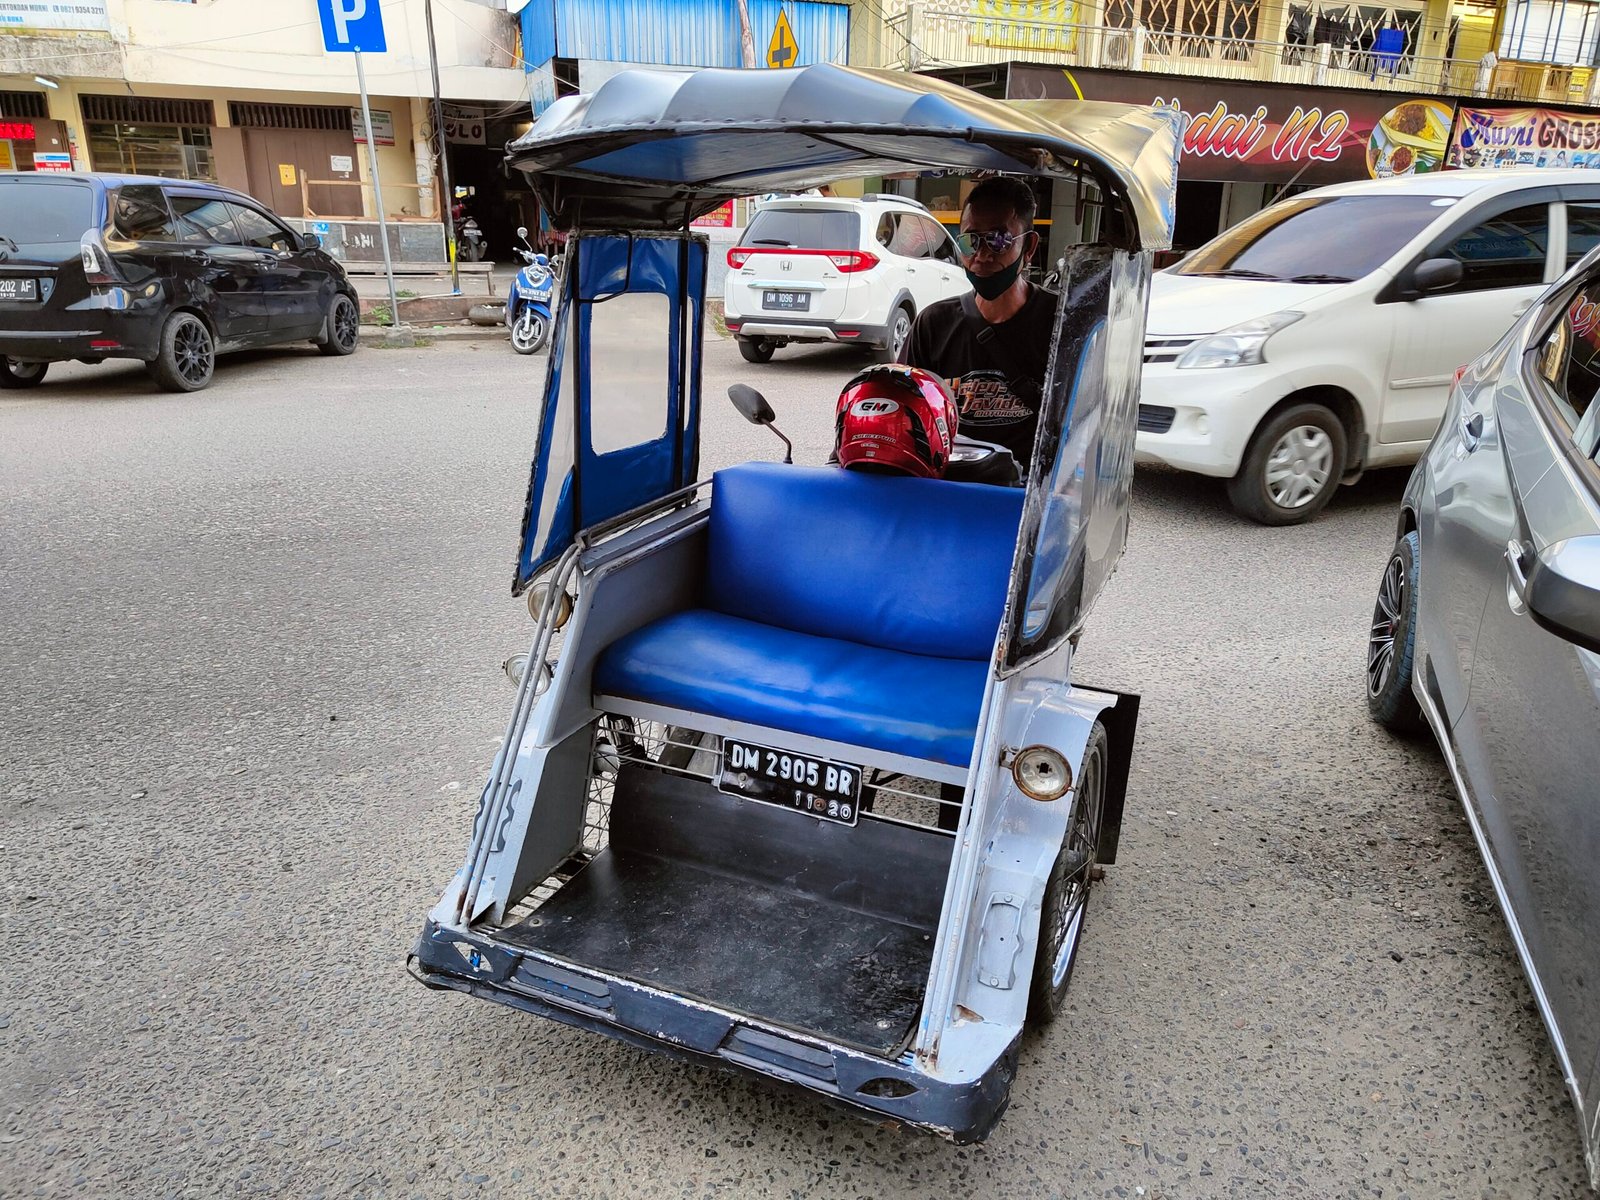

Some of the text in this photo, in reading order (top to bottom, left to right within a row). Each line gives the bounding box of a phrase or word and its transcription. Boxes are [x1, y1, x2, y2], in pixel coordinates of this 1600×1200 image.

[330, 0, 366, 43] P
[1272, 106, 1349, 162] N2
[1461, 113, 1537, 148] Murni
[21, 280, 31, 292] AF
[779, 293, 793, 303] 1096
[797, 294, 806, 303] AM
[861, 402, 889, 411] GM
[731, 744, 853, 796] DM 2905 BR
[828, 800, 851, 819] 20
